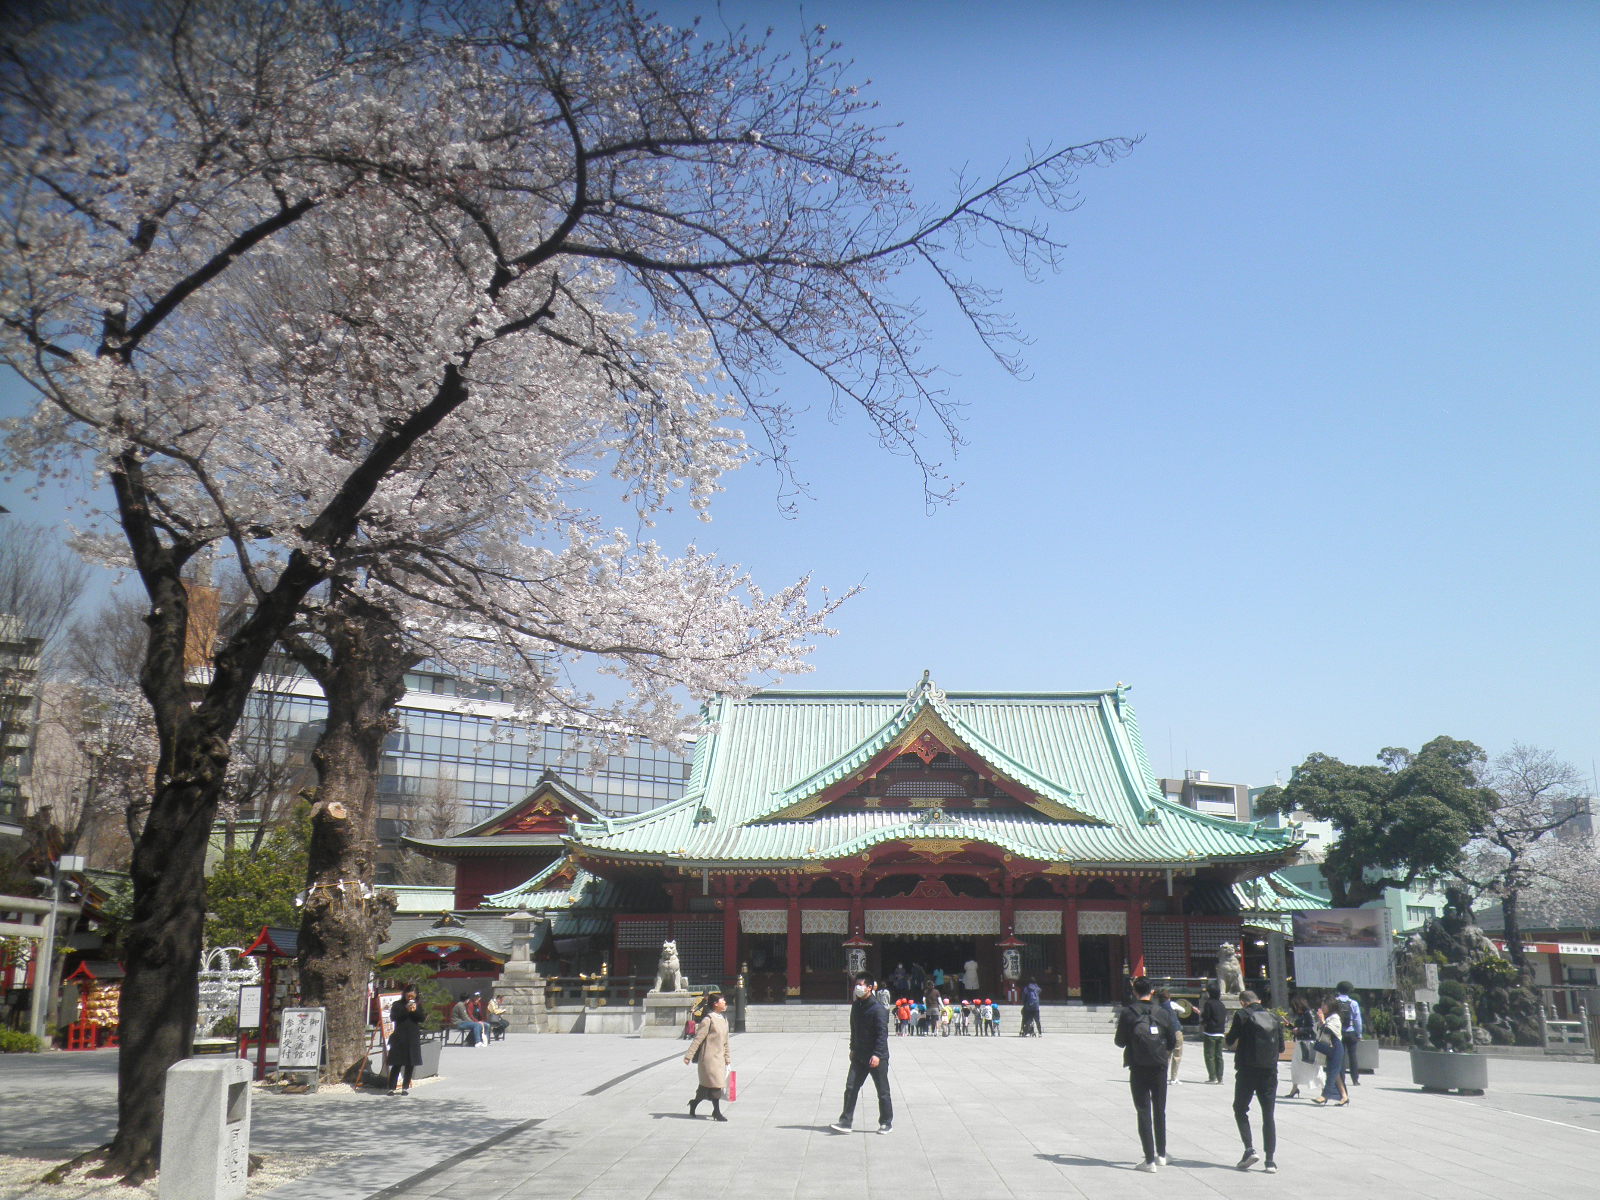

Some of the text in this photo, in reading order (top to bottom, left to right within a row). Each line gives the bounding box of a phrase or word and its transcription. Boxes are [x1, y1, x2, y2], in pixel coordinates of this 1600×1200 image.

[282, 1018, 294, 1059] 参拝受付
[305, 1018, 320, 1059] 御朱印
